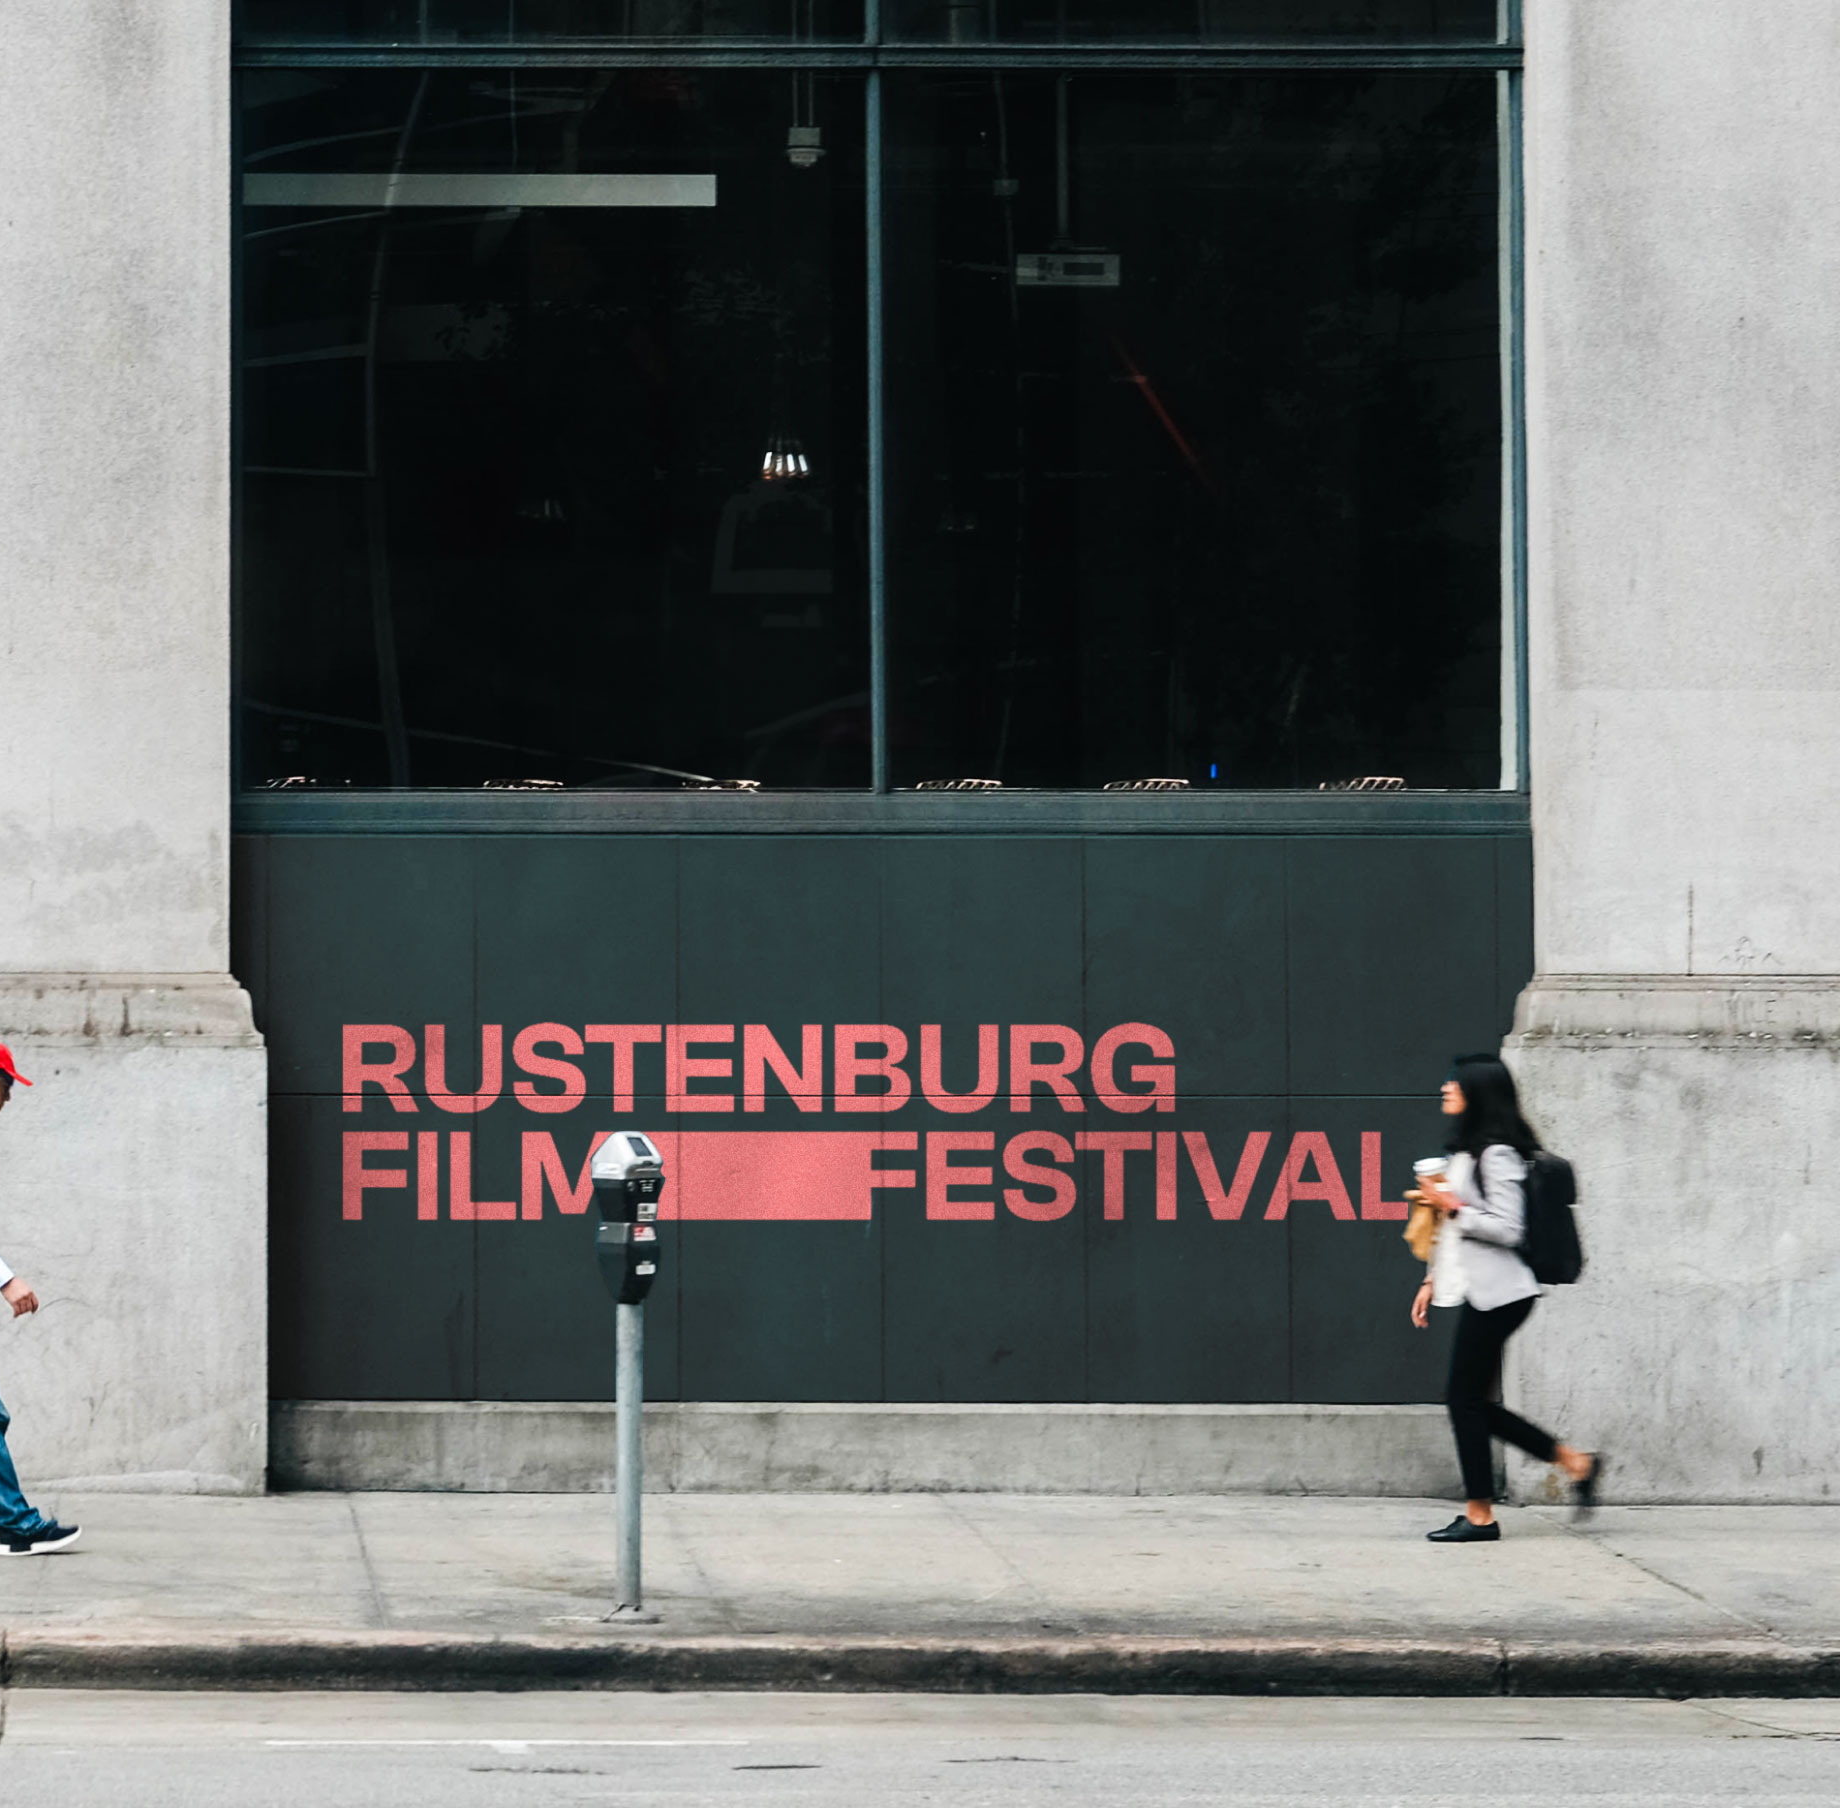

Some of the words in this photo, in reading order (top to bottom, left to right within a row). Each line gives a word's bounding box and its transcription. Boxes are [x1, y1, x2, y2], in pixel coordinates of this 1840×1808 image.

[342, 1022, 1176, 1115] RUSTENBURG
[342, 1131, 616, 1221] FILM
[852, 1131, 1409, 1221] FESTIVAL
